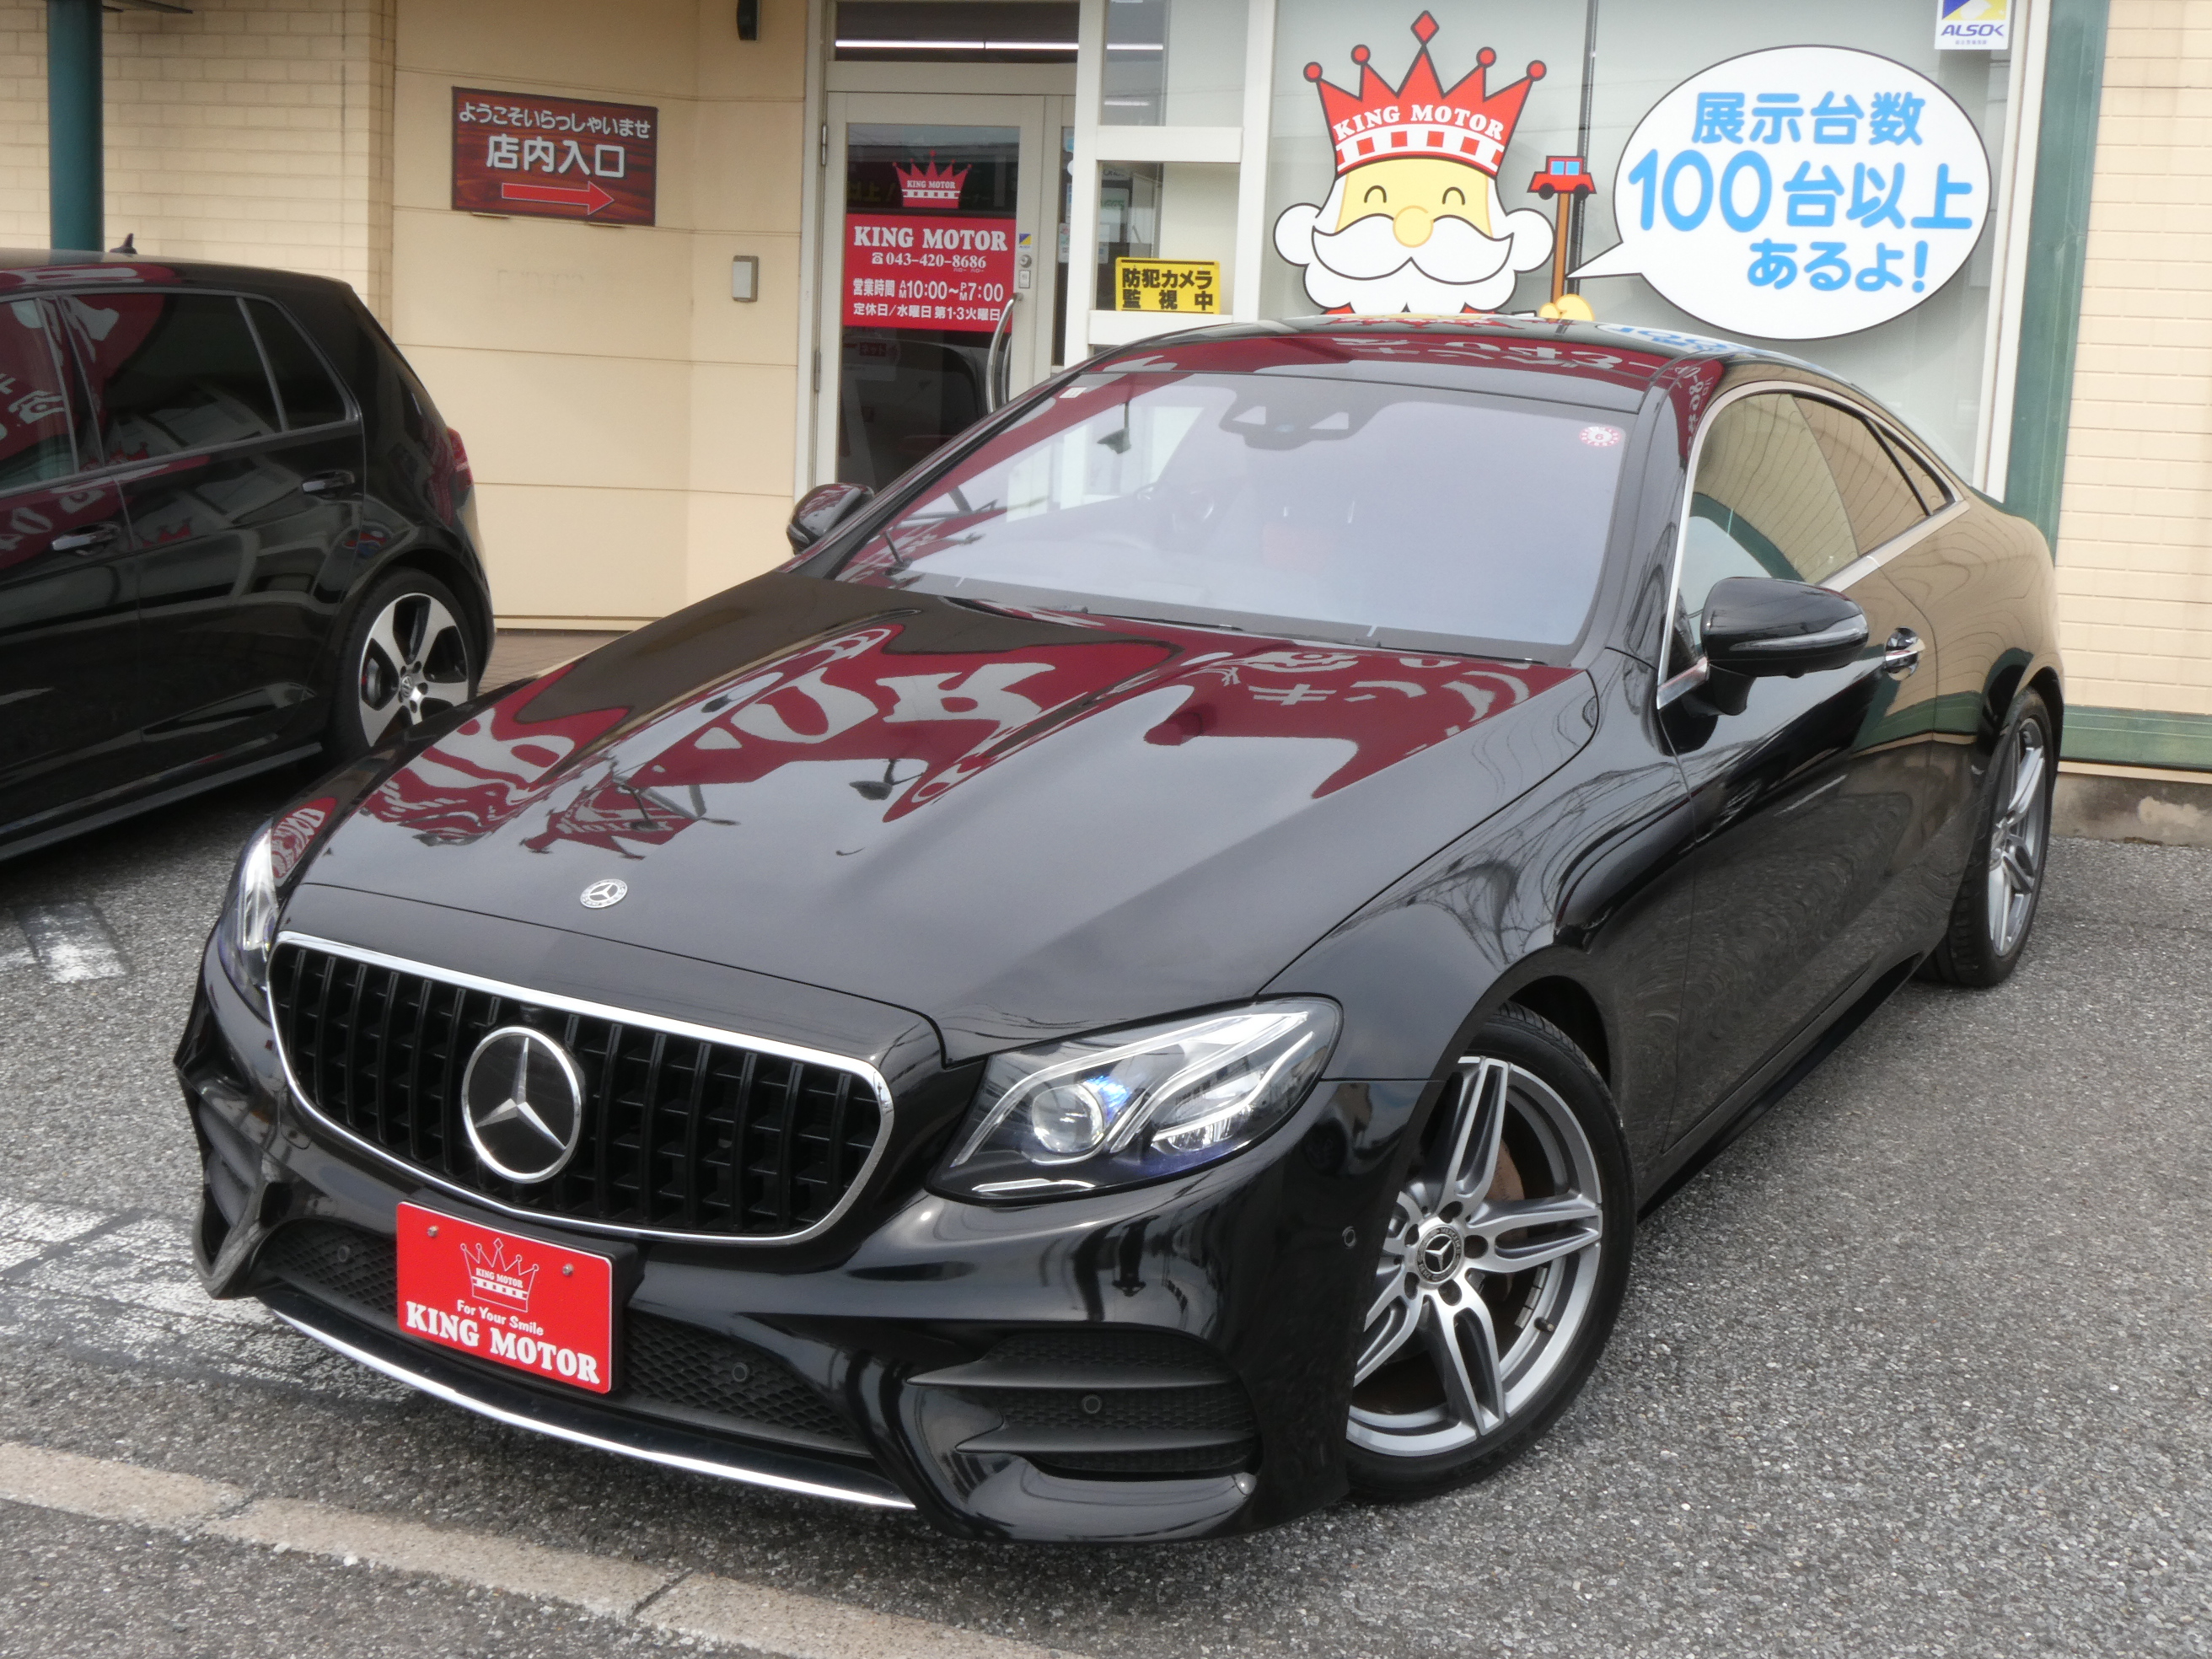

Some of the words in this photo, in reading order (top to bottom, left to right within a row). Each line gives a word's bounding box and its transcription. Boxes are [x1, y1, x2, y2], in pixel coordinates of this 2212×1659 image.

[1941, 24, 2005, 36] ALSOK
[1332, 105, 1400, 141] KING
[1411, 104, 1505, 141] MOTOR
[1692, 91, 1925, 145] 展示台数
[486, 133, 625, 178] 店内入口
[907, 180, 926, 188] KING
[928, 180, 956, 189] MOTOR
[1628, 148, 1973, 233] 100台以上
[854, 226, 914, 248] KING
[922, 228, 1008, 251] MOTOR
[886, 253, 987, 268] 043-420-8686
[1748, 239, 1929, 293] あるよ!
[853, 278, 895, 298] 営業時間
[1122, 268, 1213, 289] 防犯カメラ
[475, 1267, 495, 1280] KING
[497, 1273, 523, 1289] MOTOR
[457, 1299, 476, 1316] For
[479, 1307, 507, 1325] Your
[509, 1315, 544, 1336] Smile
[405, 1301, 480, 1347] KING
[490, 1327, 600, 1385] MOTOR
